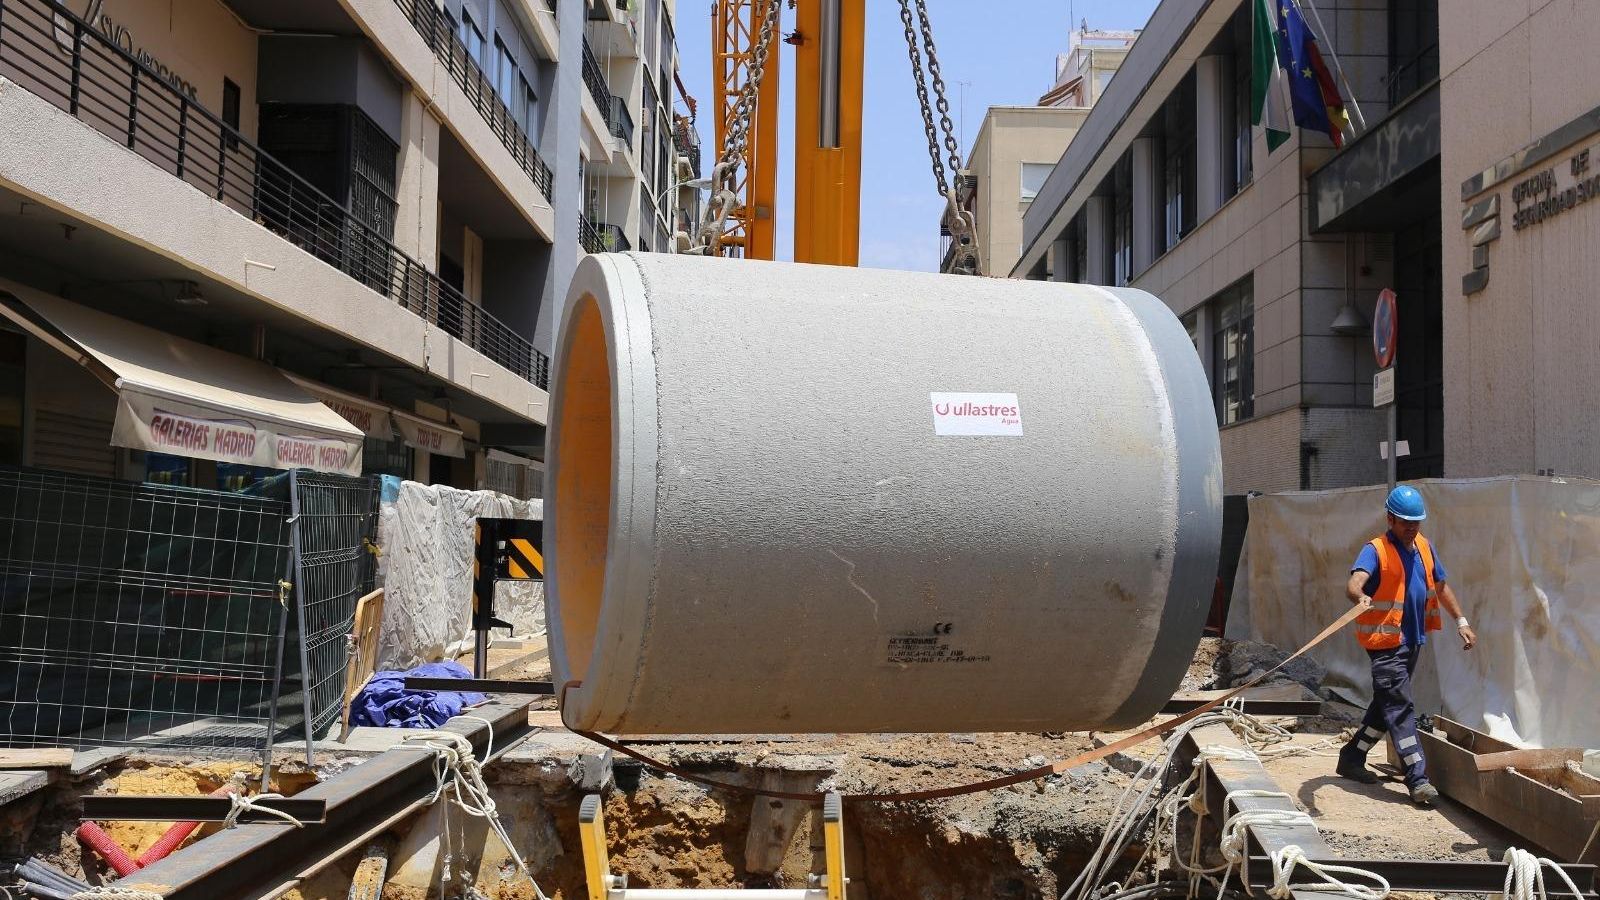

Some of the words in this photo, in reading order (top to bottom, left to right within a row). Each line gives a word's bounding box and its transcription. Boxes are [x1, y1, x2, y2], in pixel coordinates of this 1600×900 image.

[1512, 167, 1557, 202] OFICINA
[1571, 148, 1590, 176] DE
[1513, 187, 1577, 230] SEGURIDAD
[953, 402, 1017, 417] ullastres
[151, 414, 210, 450] GALERIAS
[214, 427, 256, 458] MADRID
[277, 439, 315, 466] GALERIAS
[319, 445, 348, 470] MADRID
[417, 427, 431, 447] TODO
